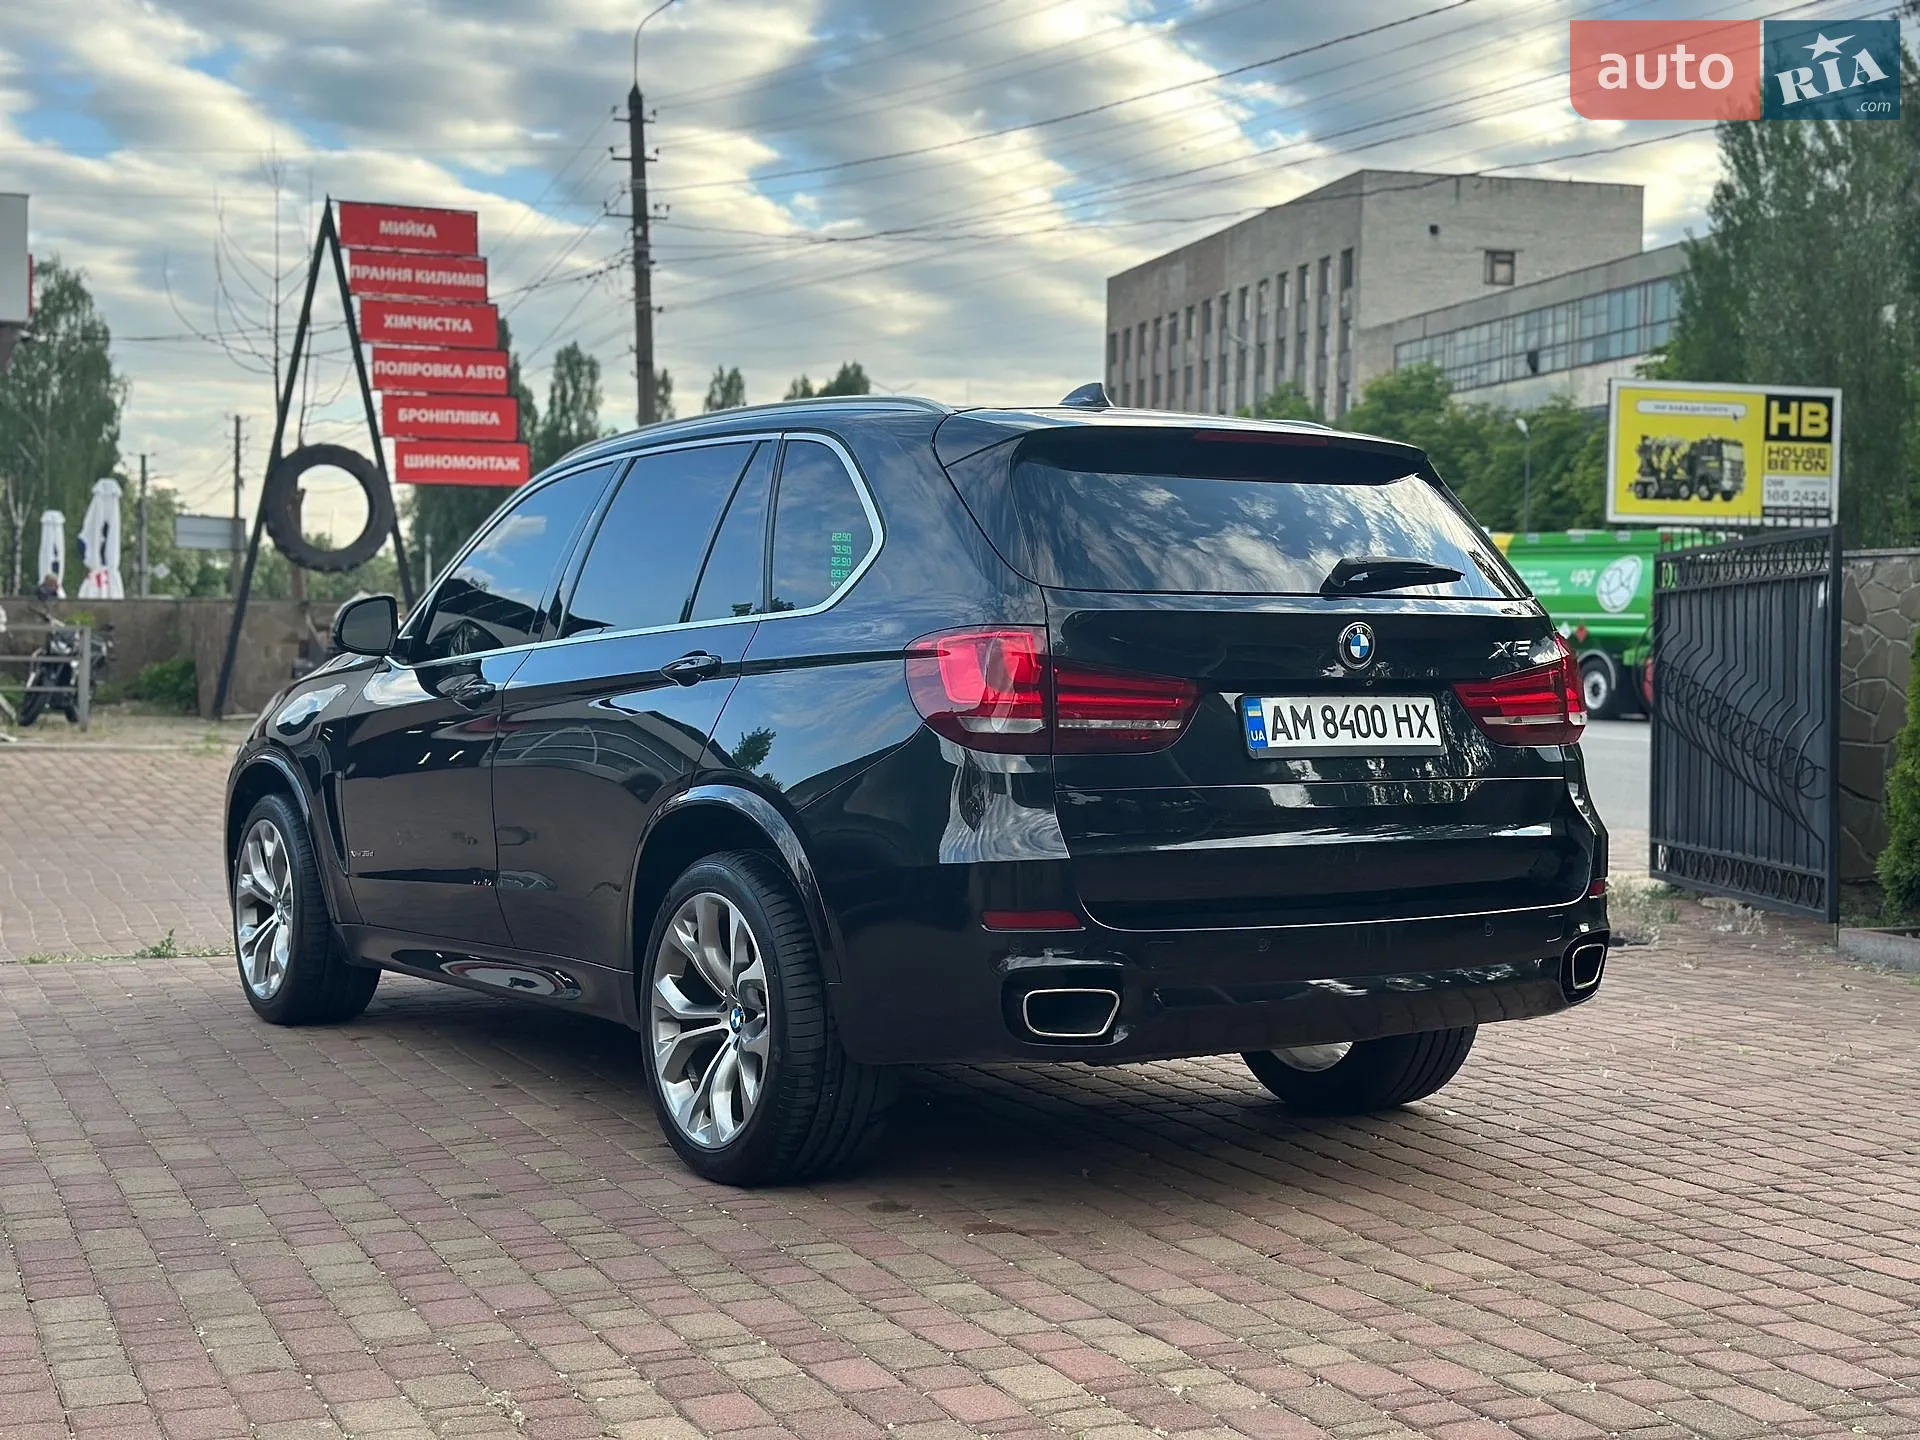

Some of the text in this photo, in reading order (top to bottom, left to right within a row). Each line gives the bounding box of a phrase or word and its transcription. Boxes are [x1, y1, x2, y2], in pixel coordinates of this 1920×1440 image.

[379, 220, 437, 238] МИЙКА
[350, 264, 486, 288] ПРАННЯ КИЛИМІВ
[383, 314, 473, 333] ХІМЧИСТКА
[374, 360, 507, 380] ПОЛІРОВКА АВТО
[398, 408, 500, 426] БРОНІПЛІВКА
[1768, 400, 1829, 438] HB
[403, 453, 520, 471] ШИНОМОНТАЖ
[1767, 446, 1827, 460] HOUSE
[1767, 459, 1827, 472] BETON
[1270, 703, 1436, 741] AM 8400 HX
[1250, 730, 1266, 742] UA
